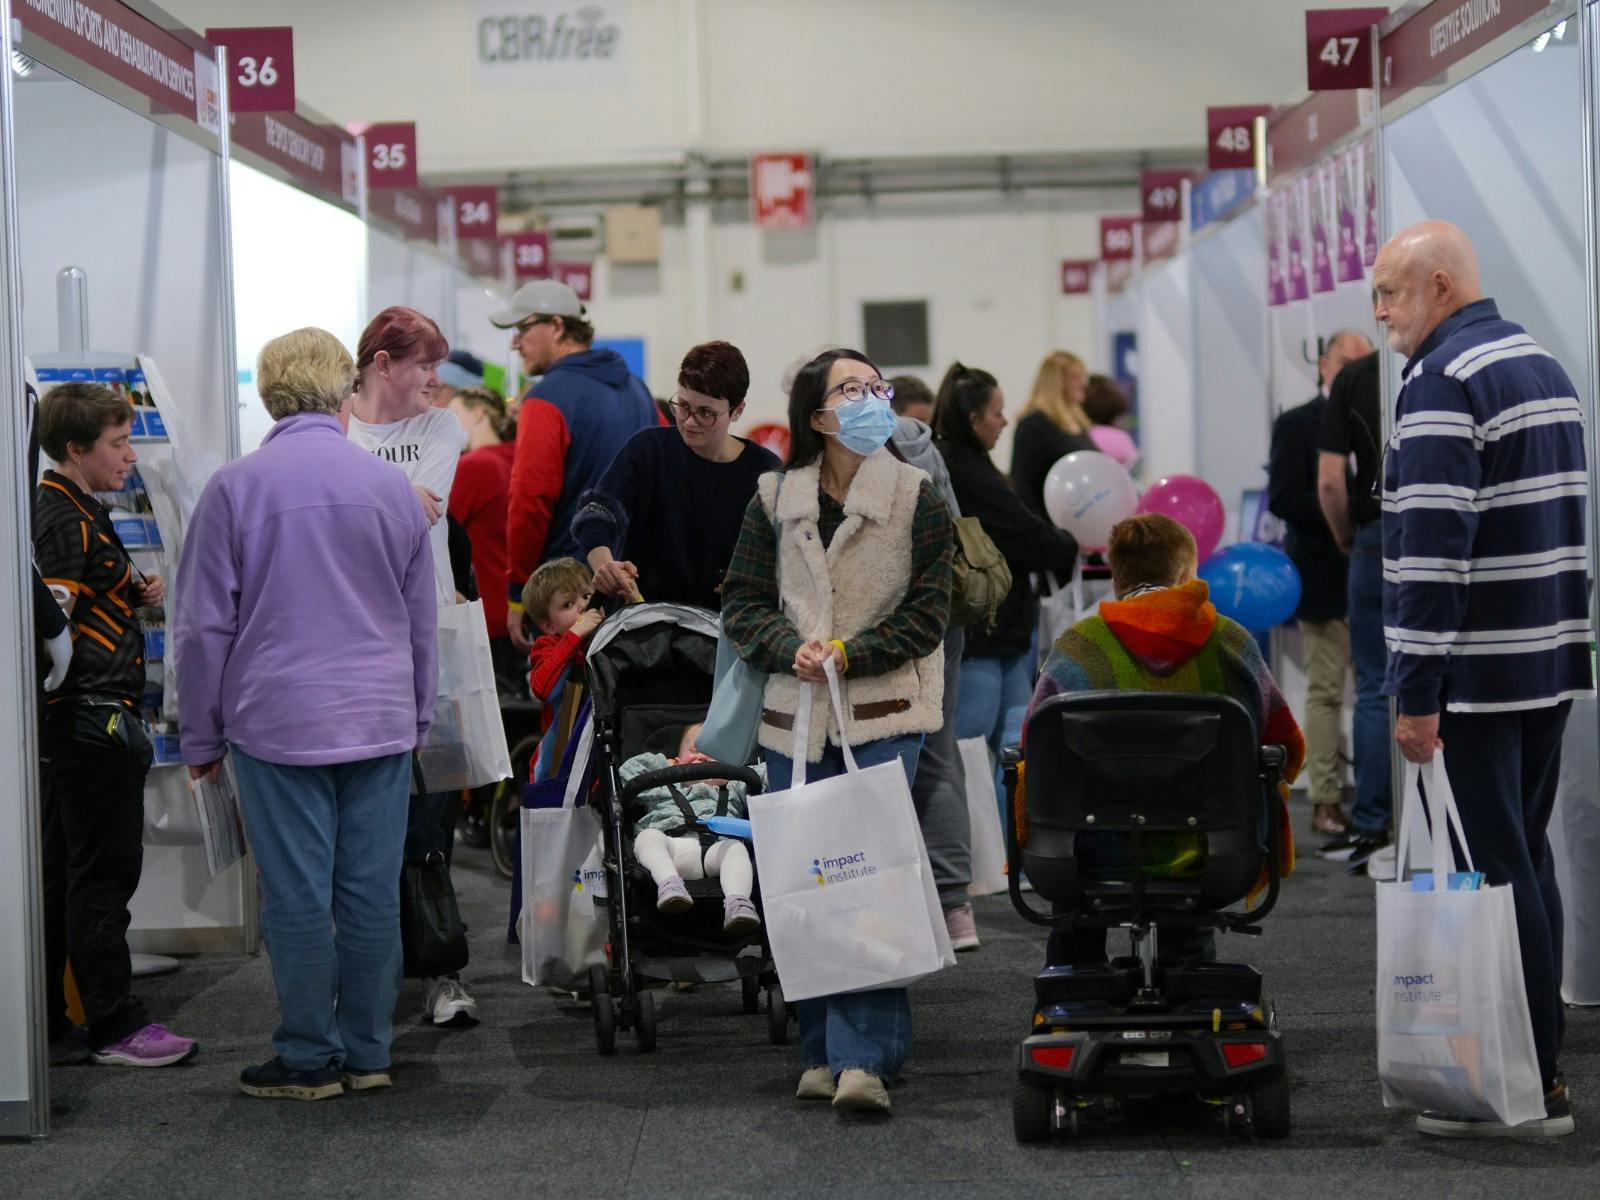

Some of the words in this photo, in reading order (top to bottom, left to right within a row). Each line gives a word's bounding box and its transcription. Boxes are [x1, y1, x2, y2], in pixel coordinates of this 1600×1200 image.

[1430, 9, 1461, 58] LIFESTYLE
[26, 0, 76, 33] ENTUM
[75, 1, 103, 48] SPORTS
[104, 18, 119, 57] AND
[120, 28, 168, 86] REHABILITATION
[168, 58, 195, 101] SERVICES
[1320, 37, 1359, 66] 47
[237, 57, 278, 86] 36
[1217, 126, 1250, 151] 48
[372, 143, 406, 169] 35
[1149, 186, 1178, 210] 49
[460, 201, 490, 225] 34
[372, 444, 419, 463] OUR
[822, 851, 866, 870] impact
[583, 869, 606, 881] imp
[825, 865, 876, 885] institute
[1393, 973, 1434, 989] mpact
[1394, 987, 1442, 1002] nstitute
